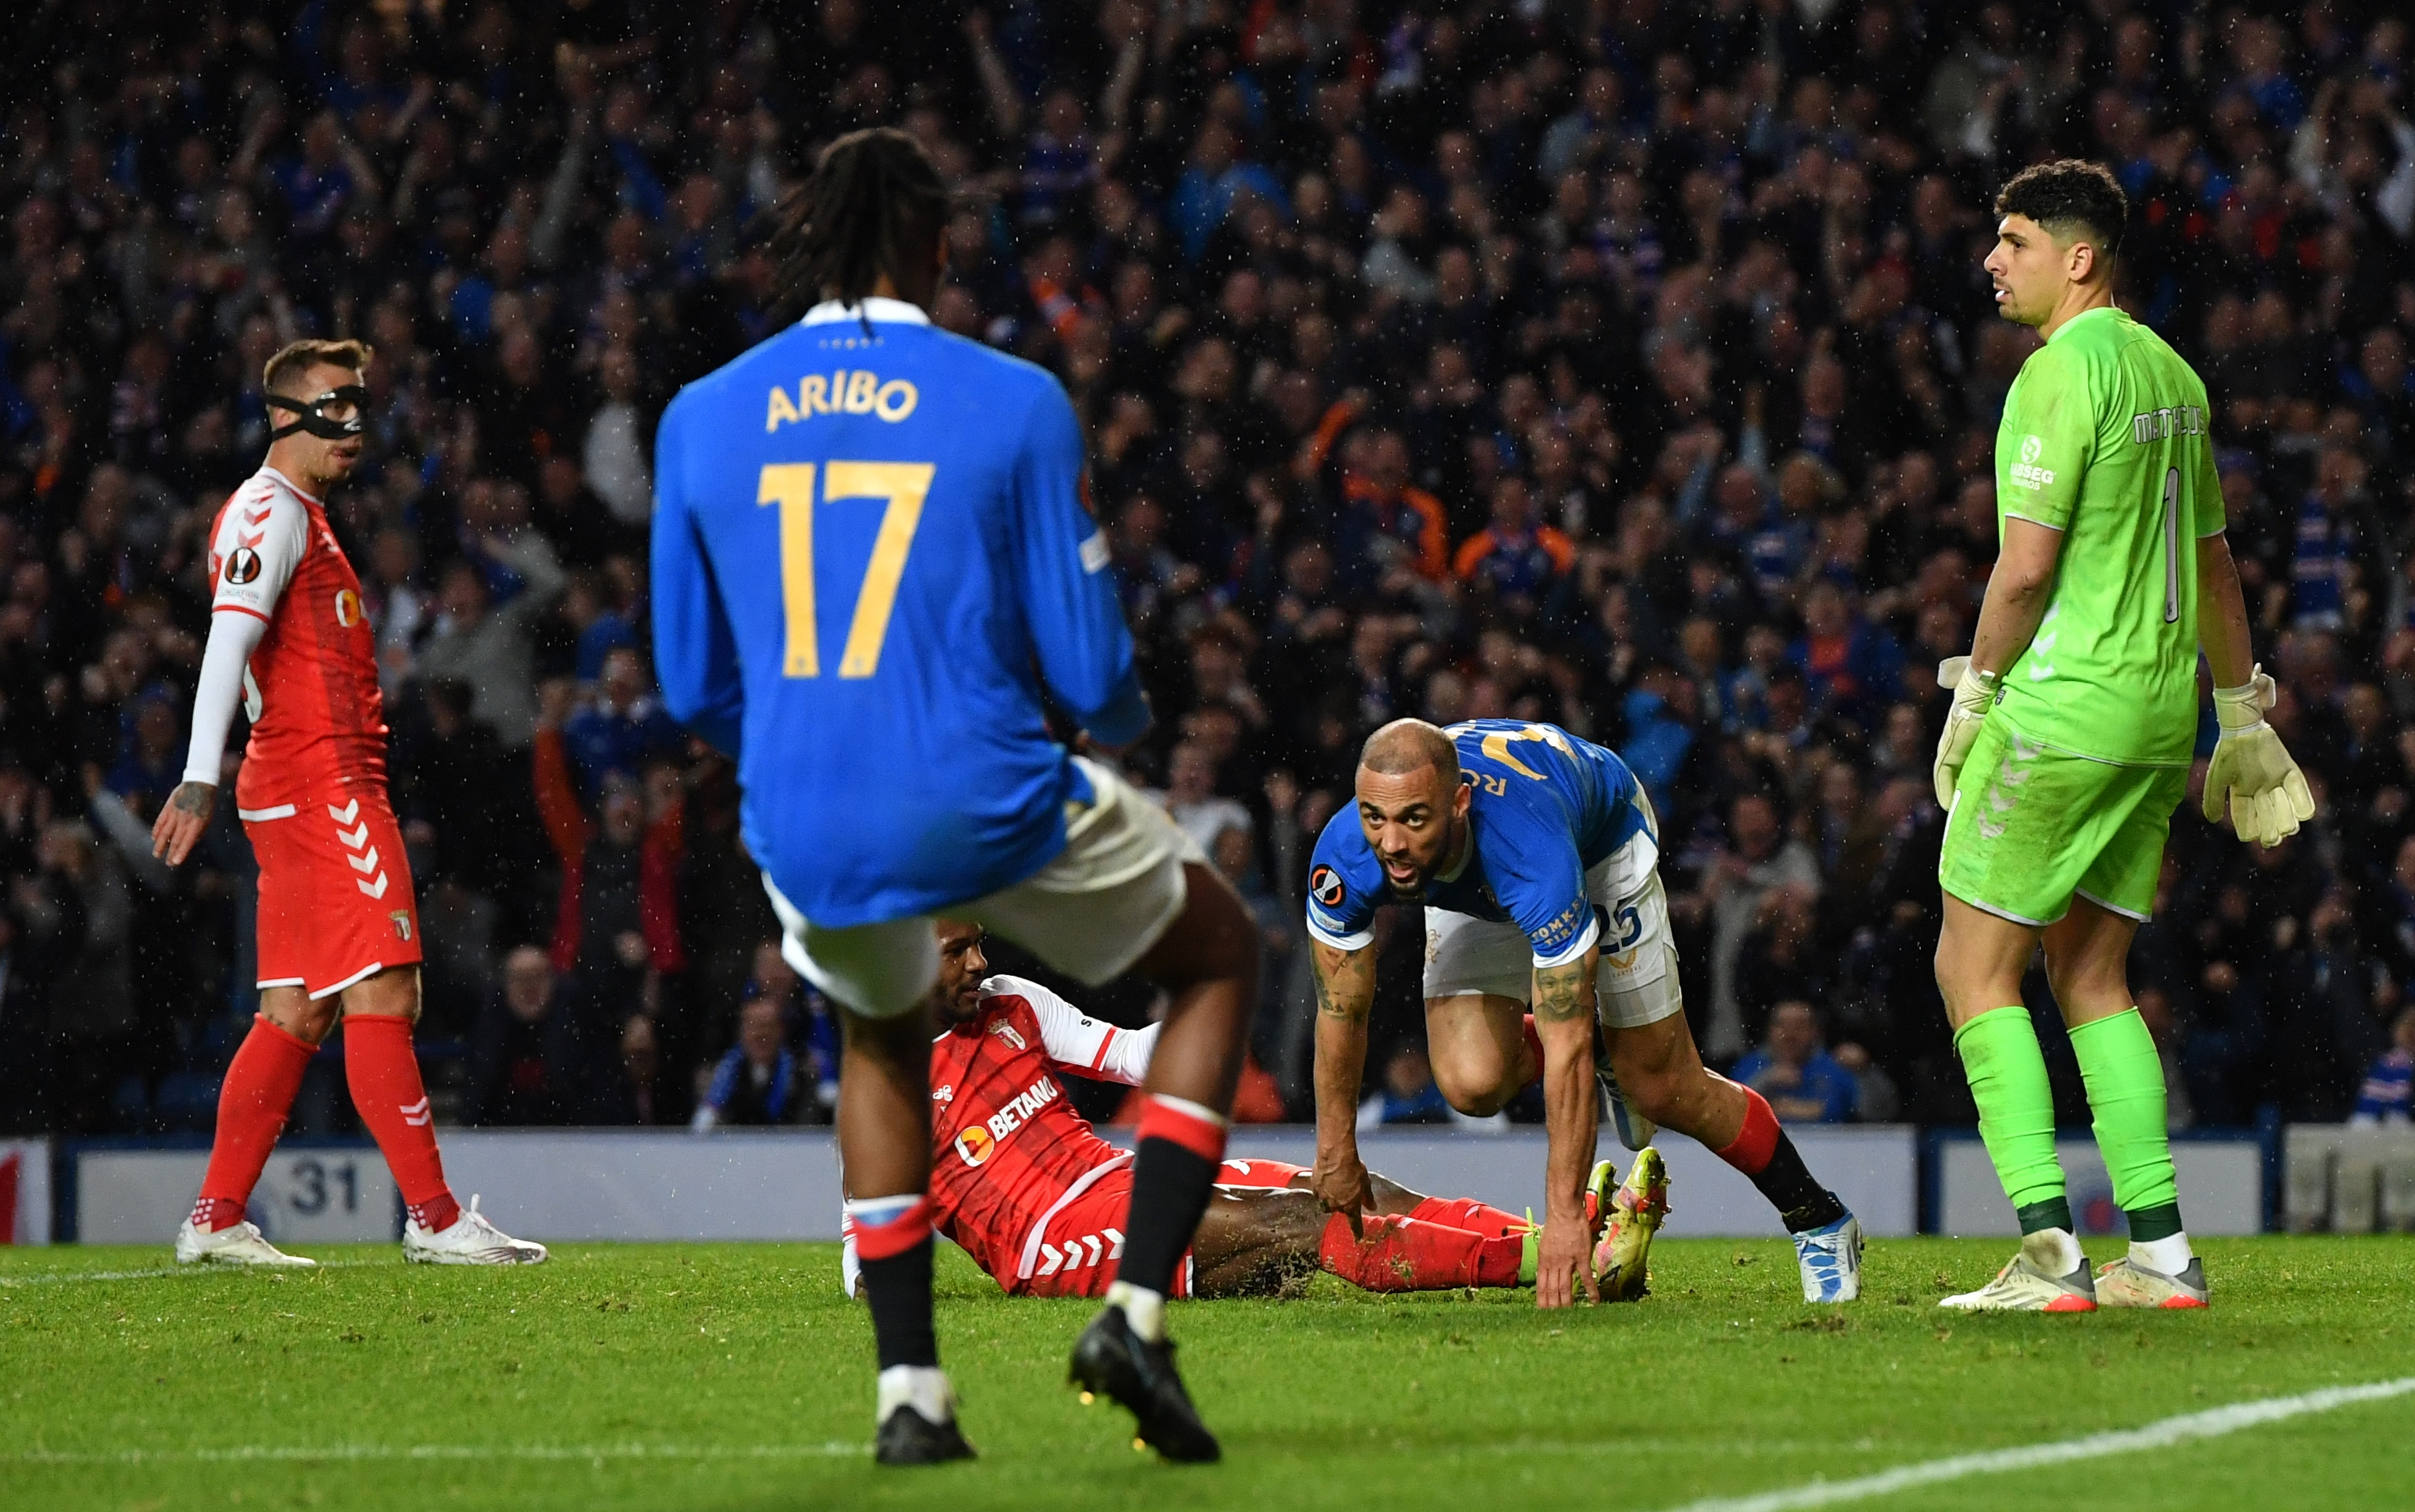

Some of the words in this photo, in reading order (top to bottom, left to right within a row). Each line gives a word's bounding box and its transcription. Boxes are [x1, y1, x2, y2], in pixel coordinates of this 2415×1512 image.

[766, 370, 918, 433] ARIBO
[757, 461, 935, 679] 17
[2163, 466, 2180, 624] 1
[1592, 897, 1642, 955] 25
[987, 1075, 1058, 1142] BETANO
[291, 1160, 358, 1216] 31
